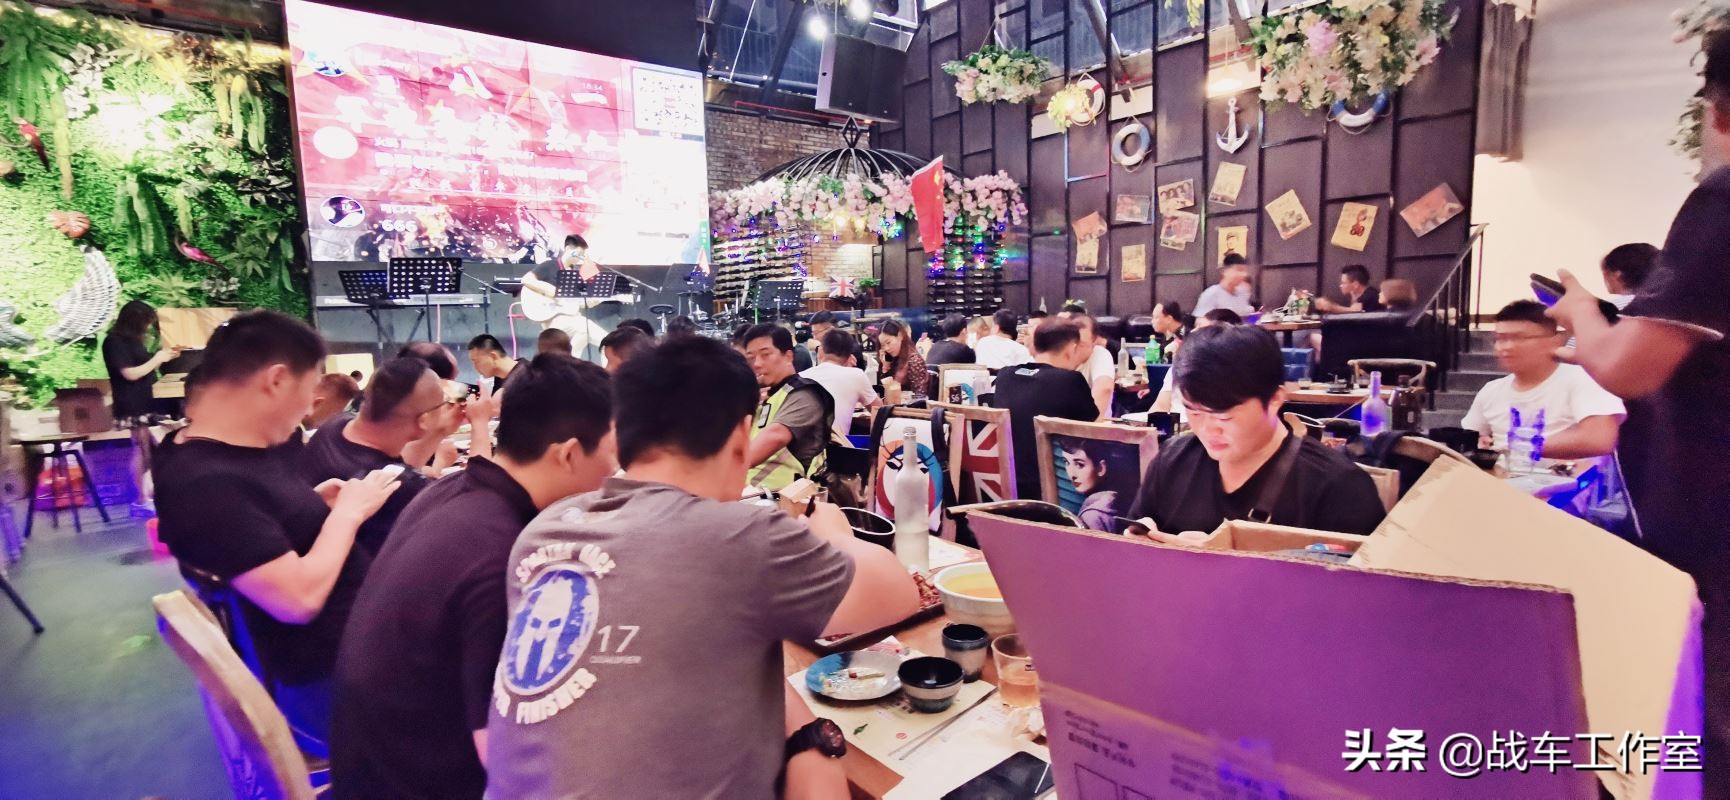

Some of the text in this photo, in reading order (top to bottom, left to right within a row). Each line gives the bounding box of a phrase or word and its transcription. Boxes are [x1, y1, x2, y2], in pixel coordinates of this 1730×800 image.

[381, 219, 418, 232] 666
[597, 625, 641, 653] 17
[516, 667, 597, 724] FINISHER
